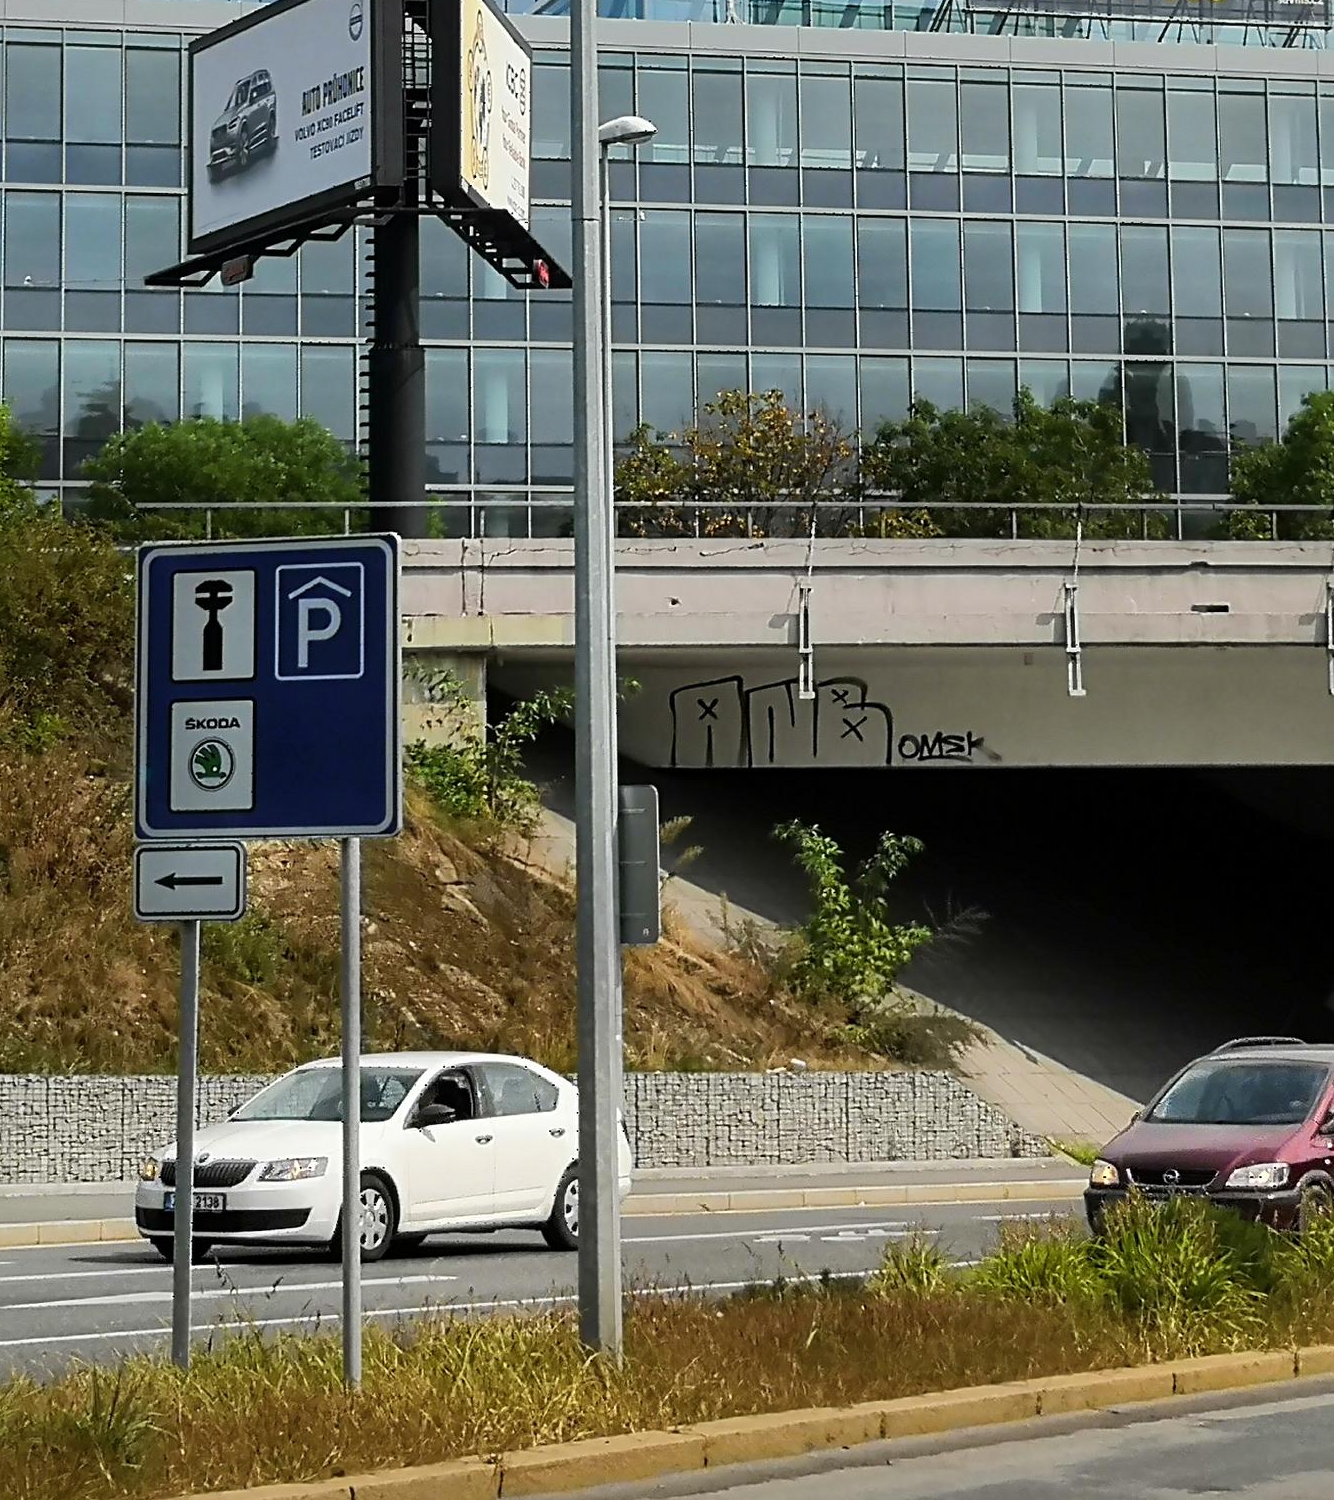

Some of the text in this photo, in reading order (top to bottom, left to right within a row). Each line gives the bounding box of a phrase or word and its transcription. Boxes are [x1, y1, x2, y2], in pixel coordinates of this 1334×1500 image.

[294, 123, 316, 141] VOLVO
[297, 597, 342, 668] P
[184, 716, 241, 730] ŠKODA
